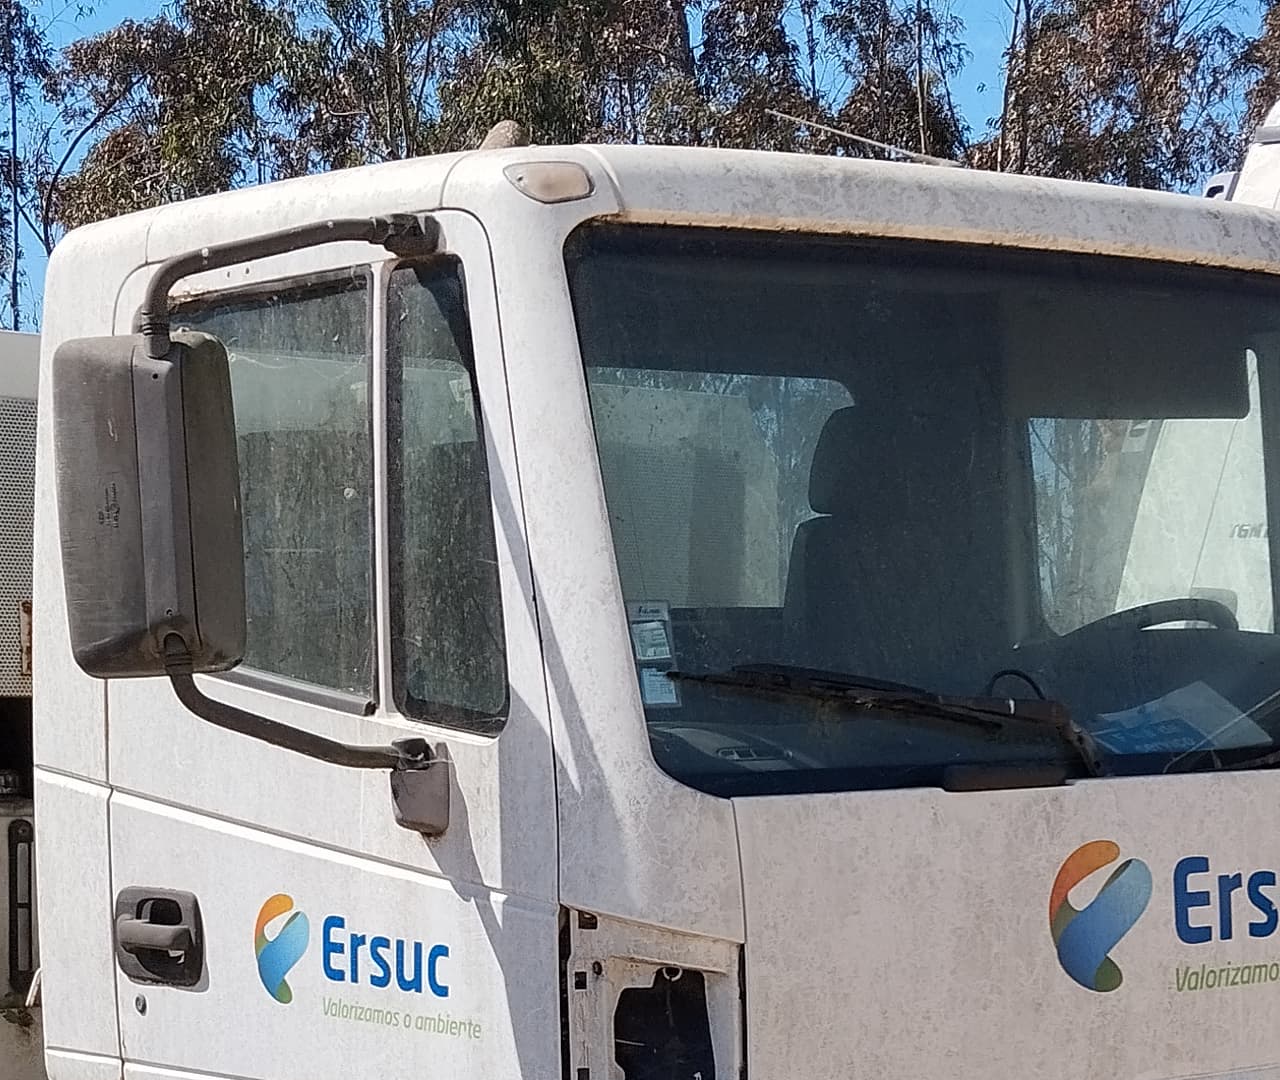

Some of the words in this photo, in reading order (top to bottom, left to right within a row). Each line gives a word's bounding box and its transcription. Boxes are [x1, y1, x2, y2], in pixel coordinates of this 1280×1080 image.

[322, 915, 450, 998] Ersuc
[322, 997, 400, 1026] Valorizamos
[403, 1012, 411, 1030] o
[414, 1012, 482, 1039] ambiente
